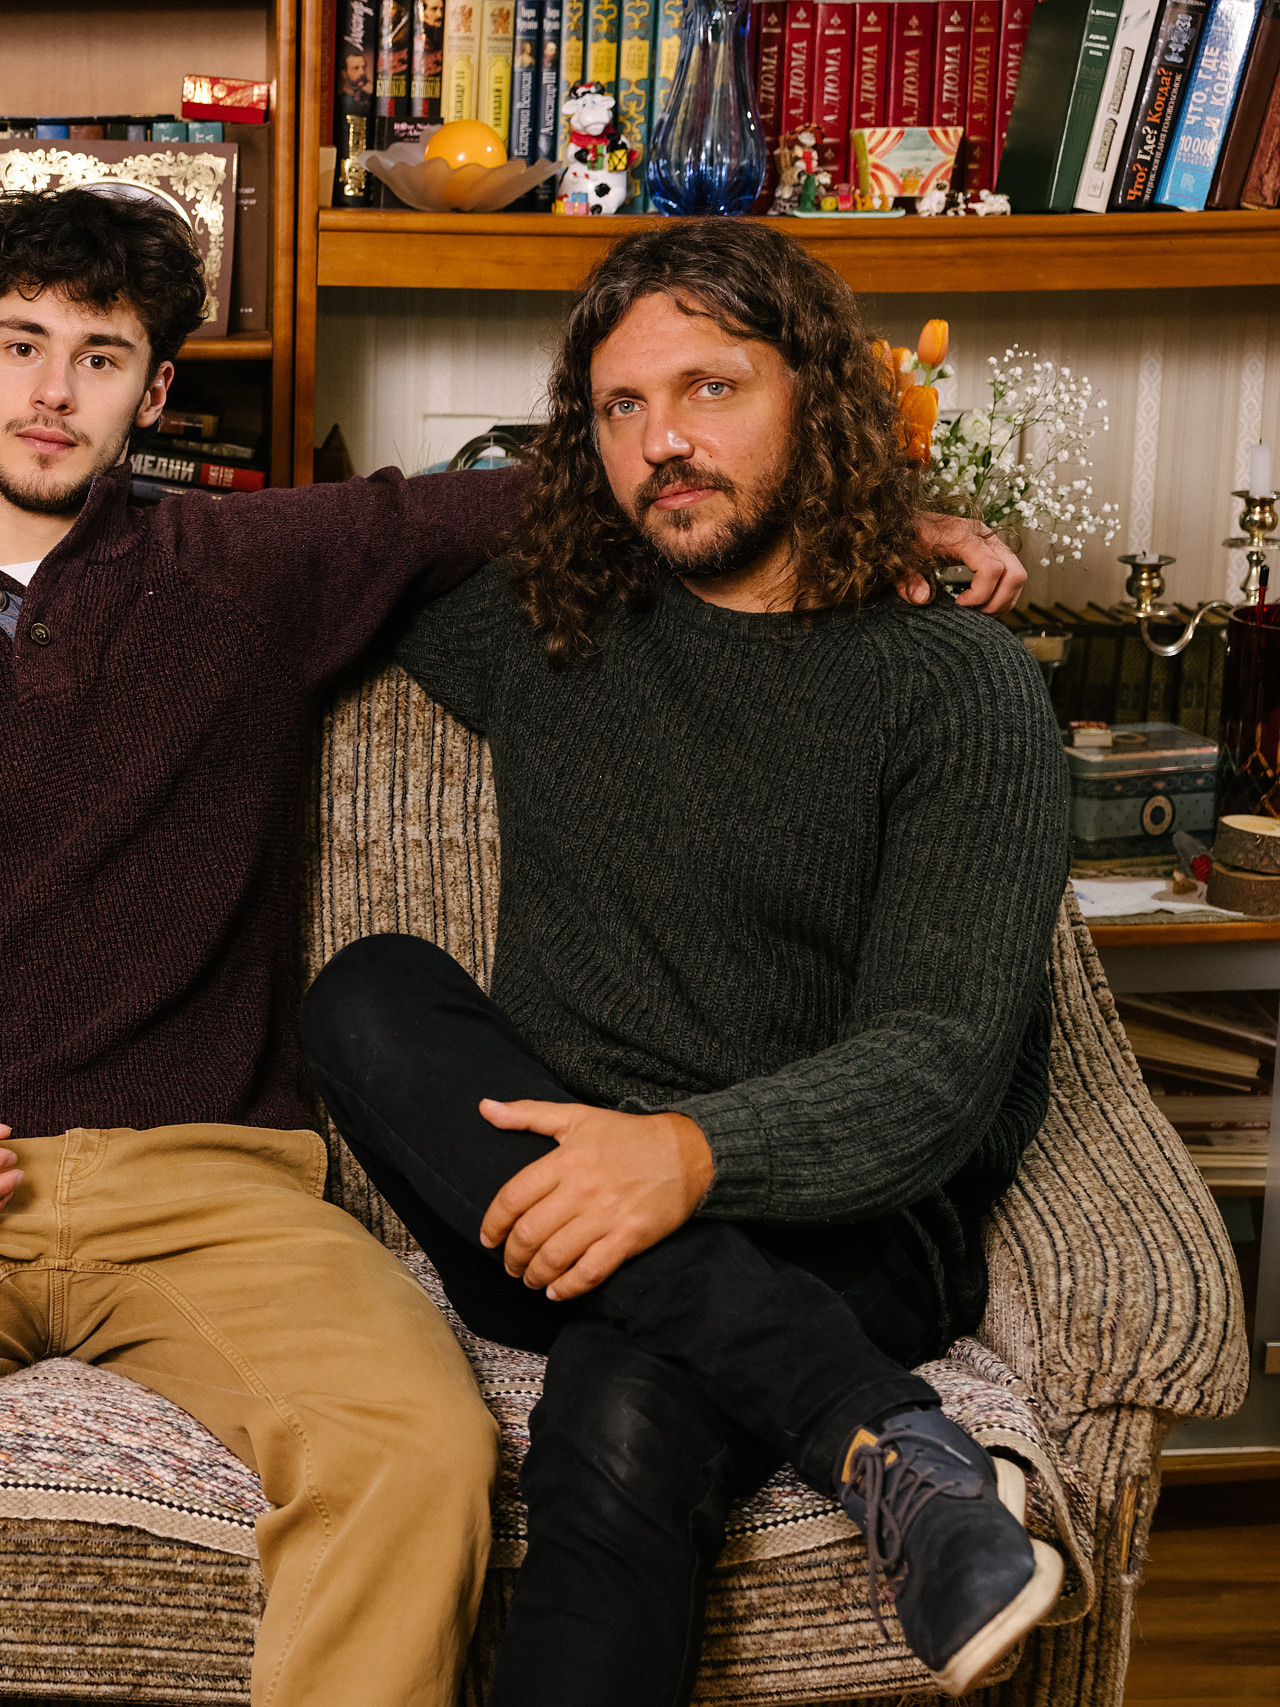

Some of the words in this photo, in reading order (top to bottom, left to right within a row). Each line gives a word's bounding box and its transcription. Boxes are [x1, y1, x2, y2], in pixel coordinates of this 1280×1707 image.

[542, 71, 557, 85] III
[789, 40, 808, 121] А.ДЮМА
[823, 46, 842, 126] А.ДЮМА
[860, 44, 879, 125] А.ДЮМА
[941, 44, 962, 126] А.ДЮМА
[971, 45, 991, 126] А.ДЮМА
[1146, 66, 1174, 124] Когда?
[1185, 87, 1212, 126] ЧТО,
[1199, 45, 1220, 81] ГДЕ
[1126, 162, 1149, 201] Что?
[1137, 124, 1159, 163] Где?
